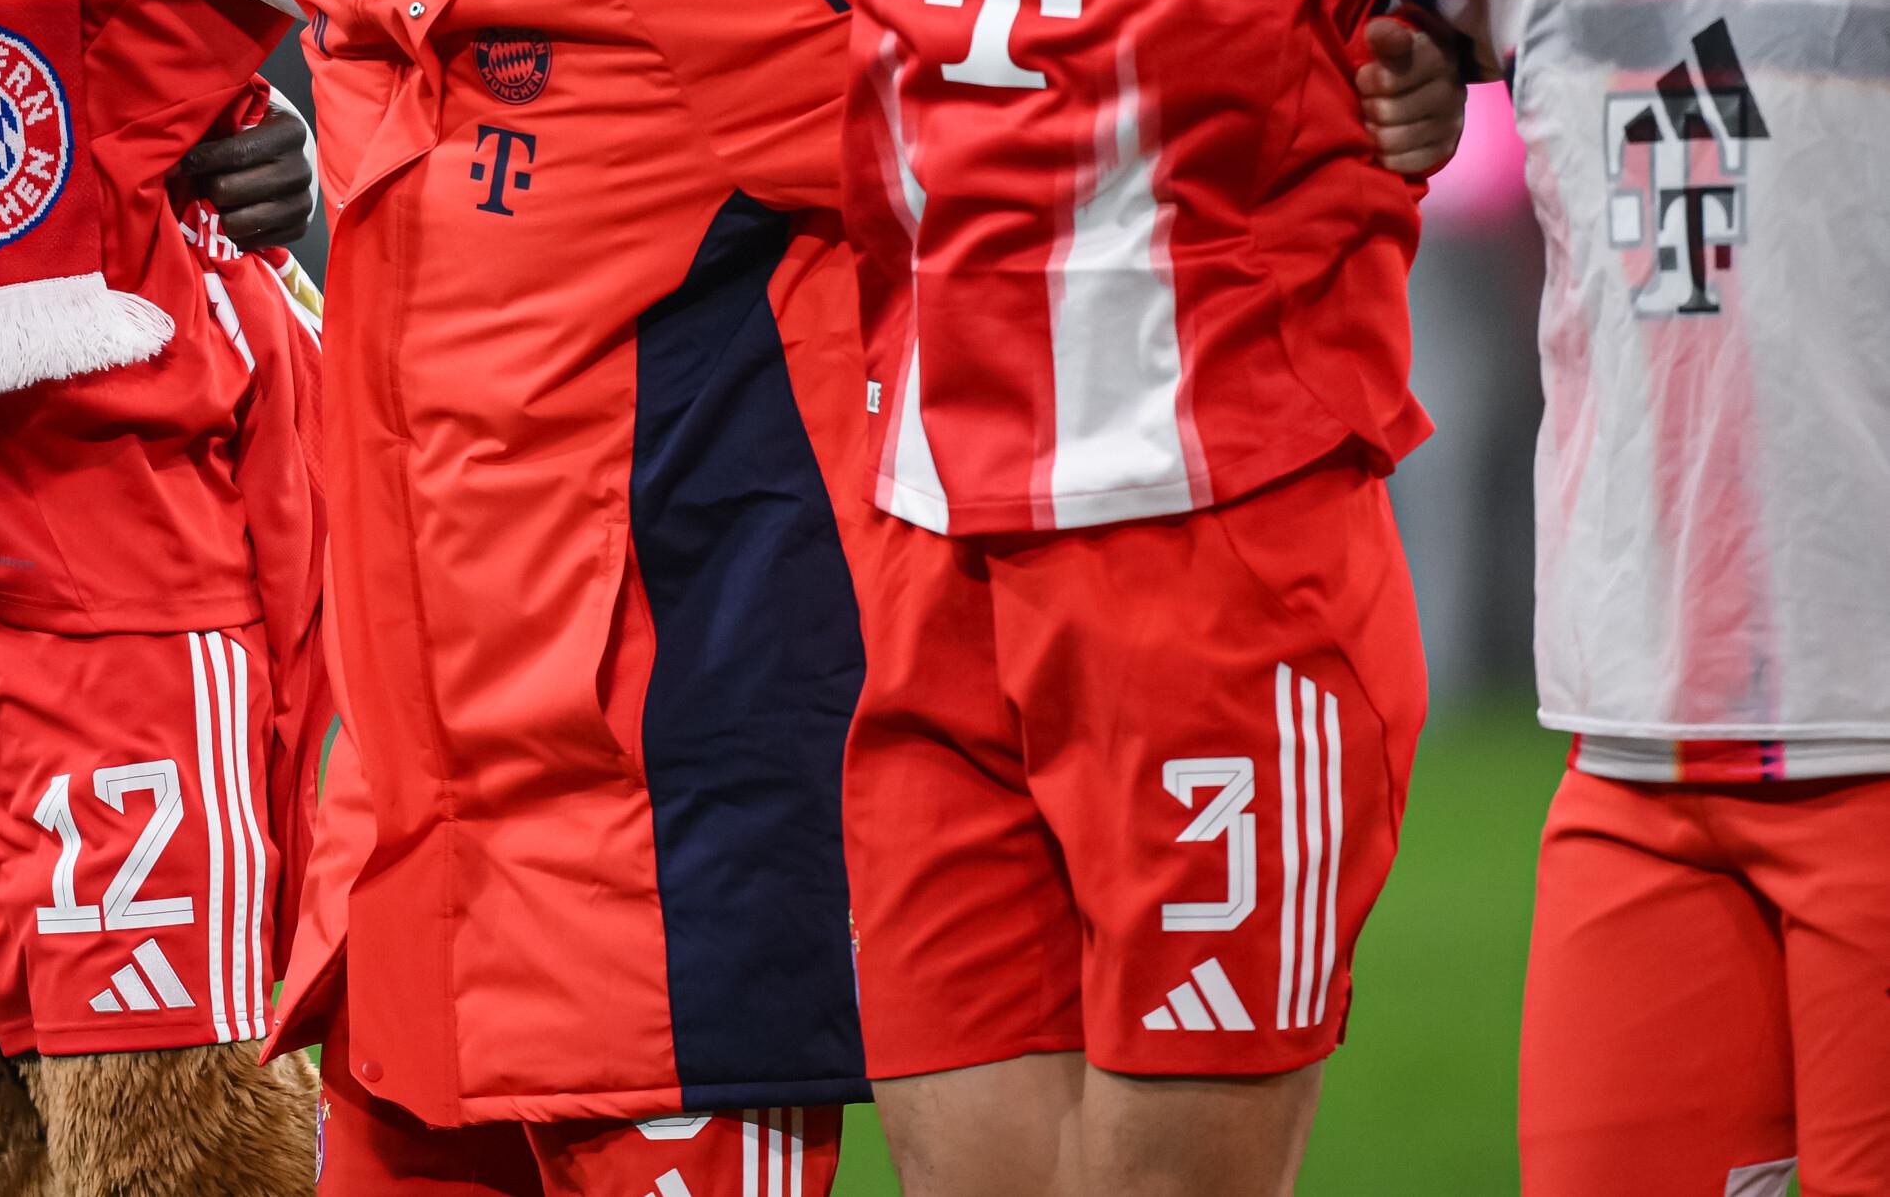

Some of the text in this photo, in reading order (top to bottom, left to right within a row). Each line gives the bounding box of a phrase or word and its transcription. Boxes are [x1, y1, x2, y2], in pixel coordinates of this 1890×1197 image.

[470, 124, 536, 217] T
[32, 759, 194, 935] 12
[1160, 757, 1256, 932] 3
